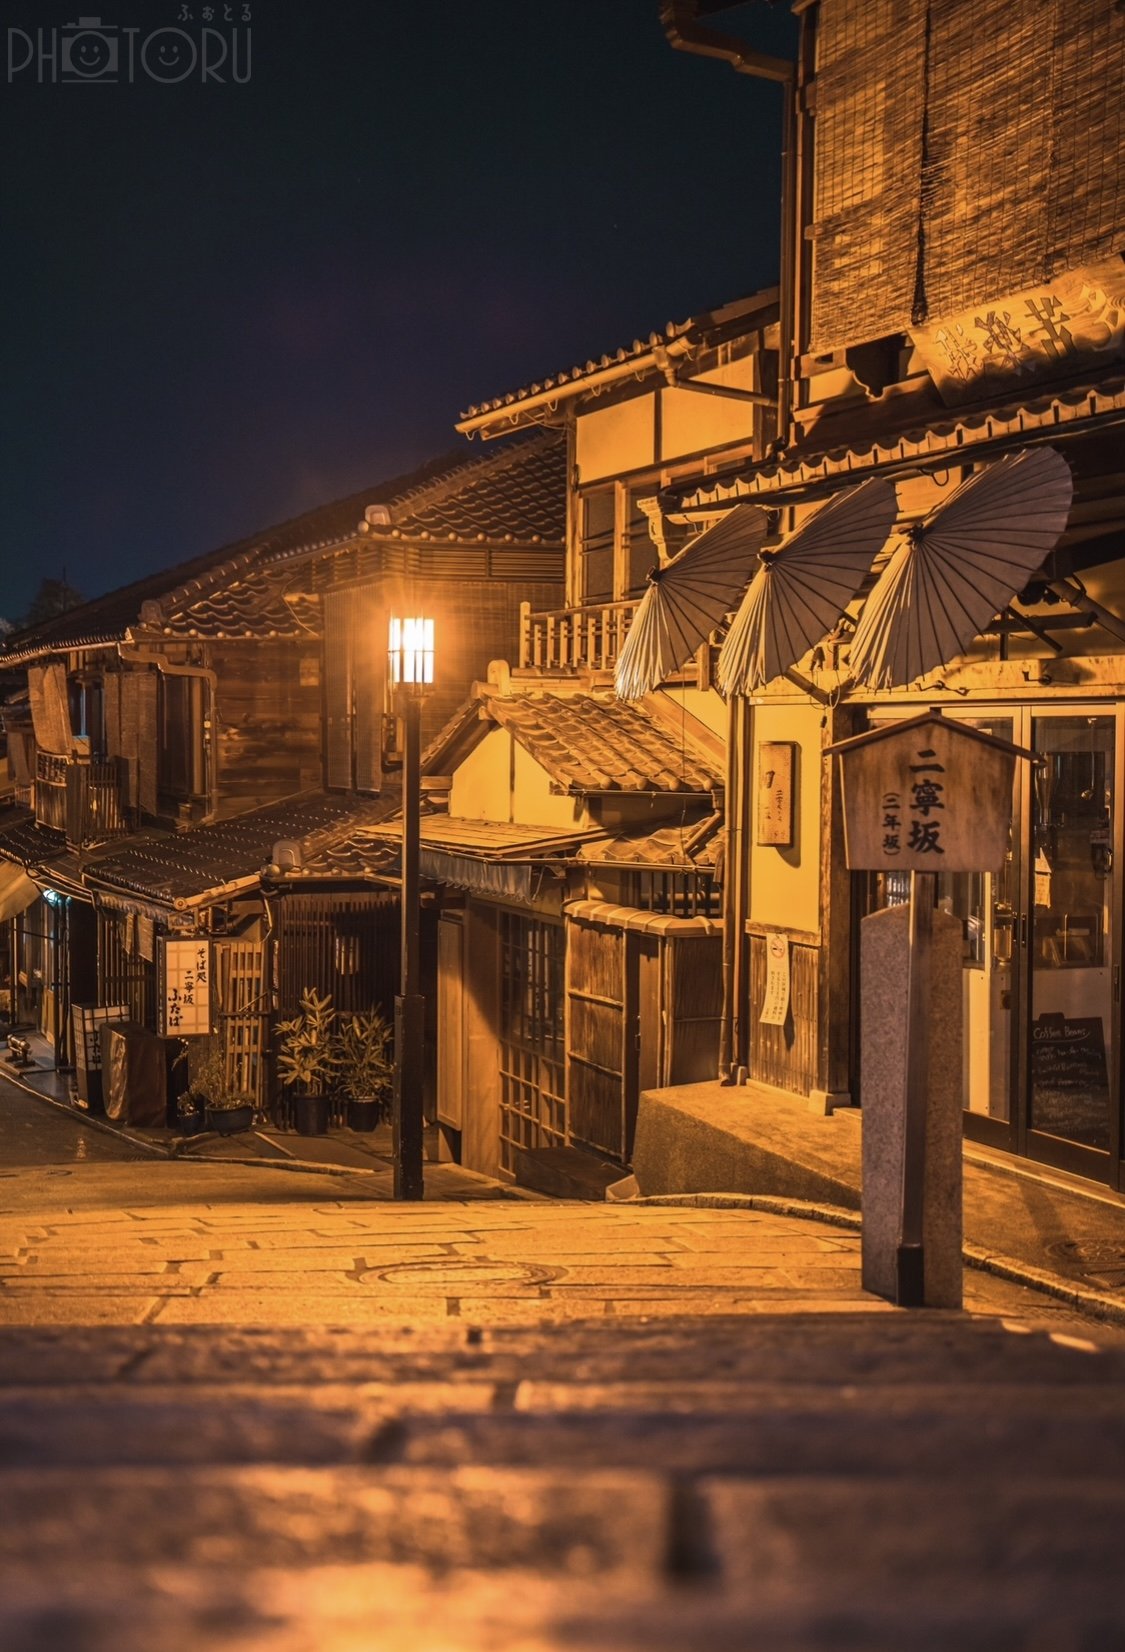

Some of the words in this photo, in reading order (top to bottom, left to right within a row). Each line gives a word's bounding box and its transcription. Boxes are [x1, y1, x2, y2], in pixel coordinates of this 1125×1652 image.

[907, 749, 945, 854] 二寧坂
[196, 948, 207, 983] そば処
[183, 970, 194, 1005] 二寧坂
[168, 988, 183, 1027] ふたば
